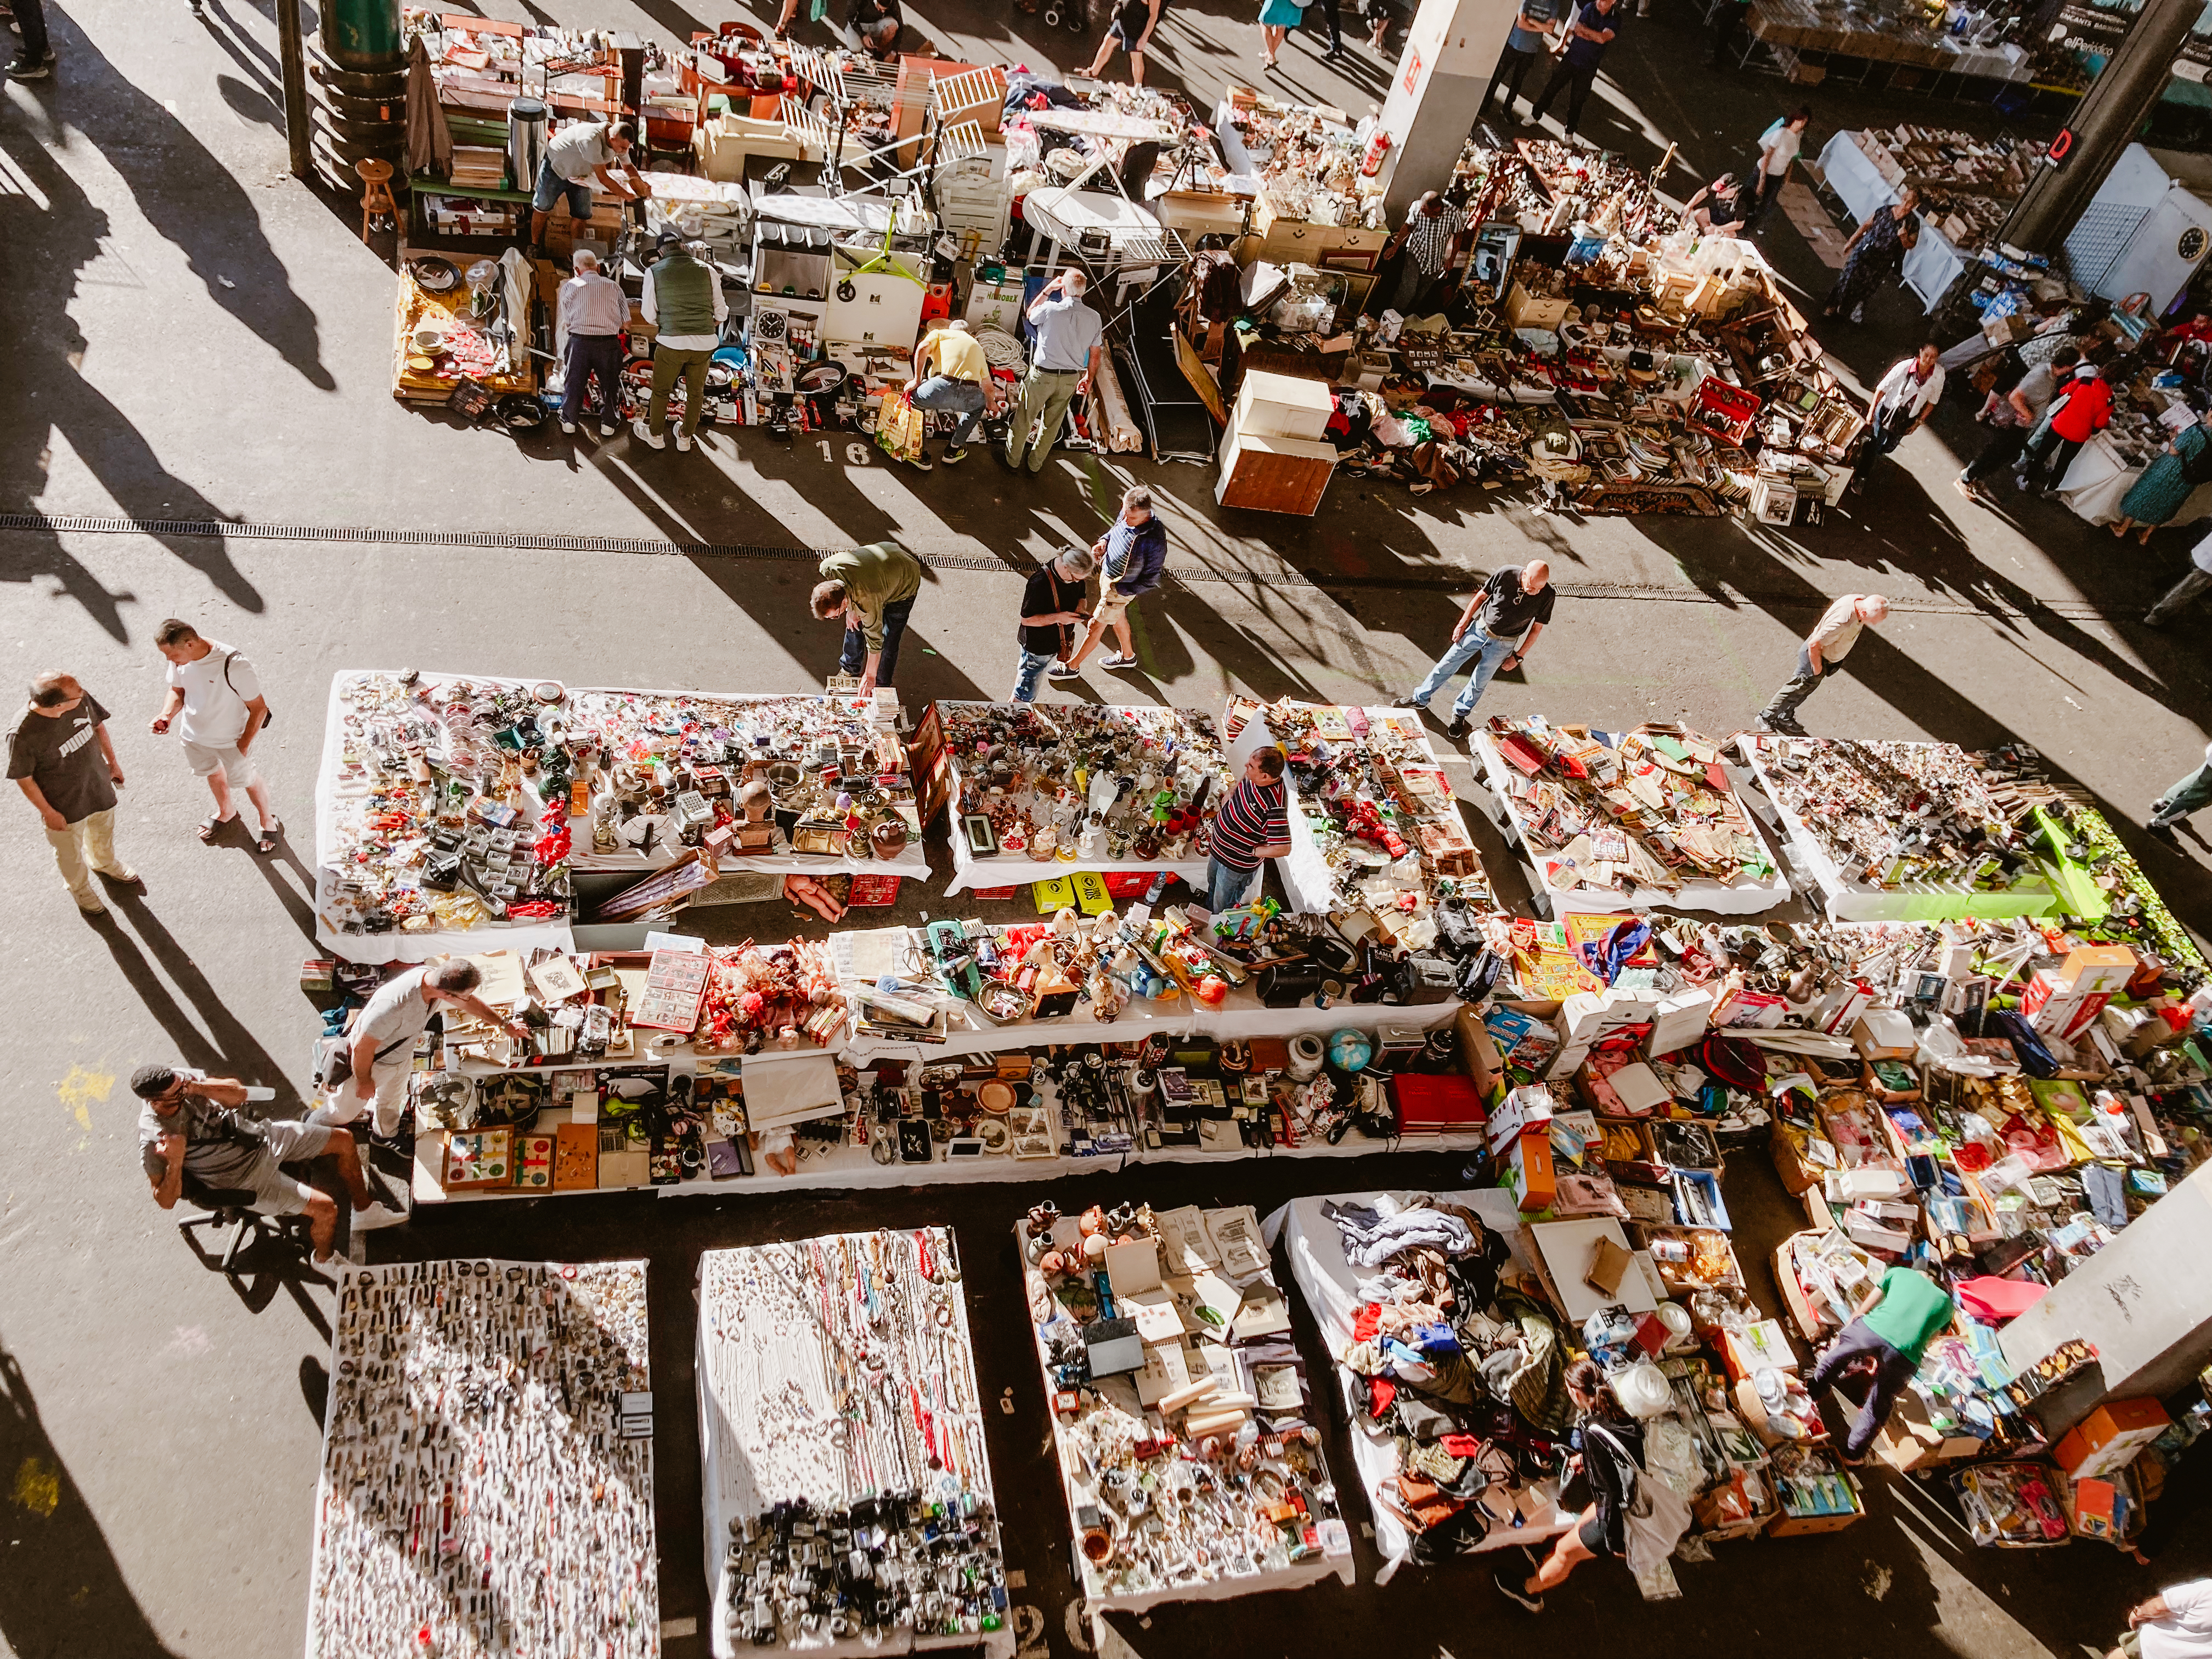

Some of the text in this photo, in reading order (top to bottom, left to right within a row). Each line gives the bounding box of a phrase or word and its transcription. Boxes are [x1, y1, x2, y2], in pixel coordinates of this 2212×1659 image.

[2049, 128, 2072, 160] D
[1374, 949, 1392, 959] KAMA
[1374, 954, 1393, 963] SUTRA
